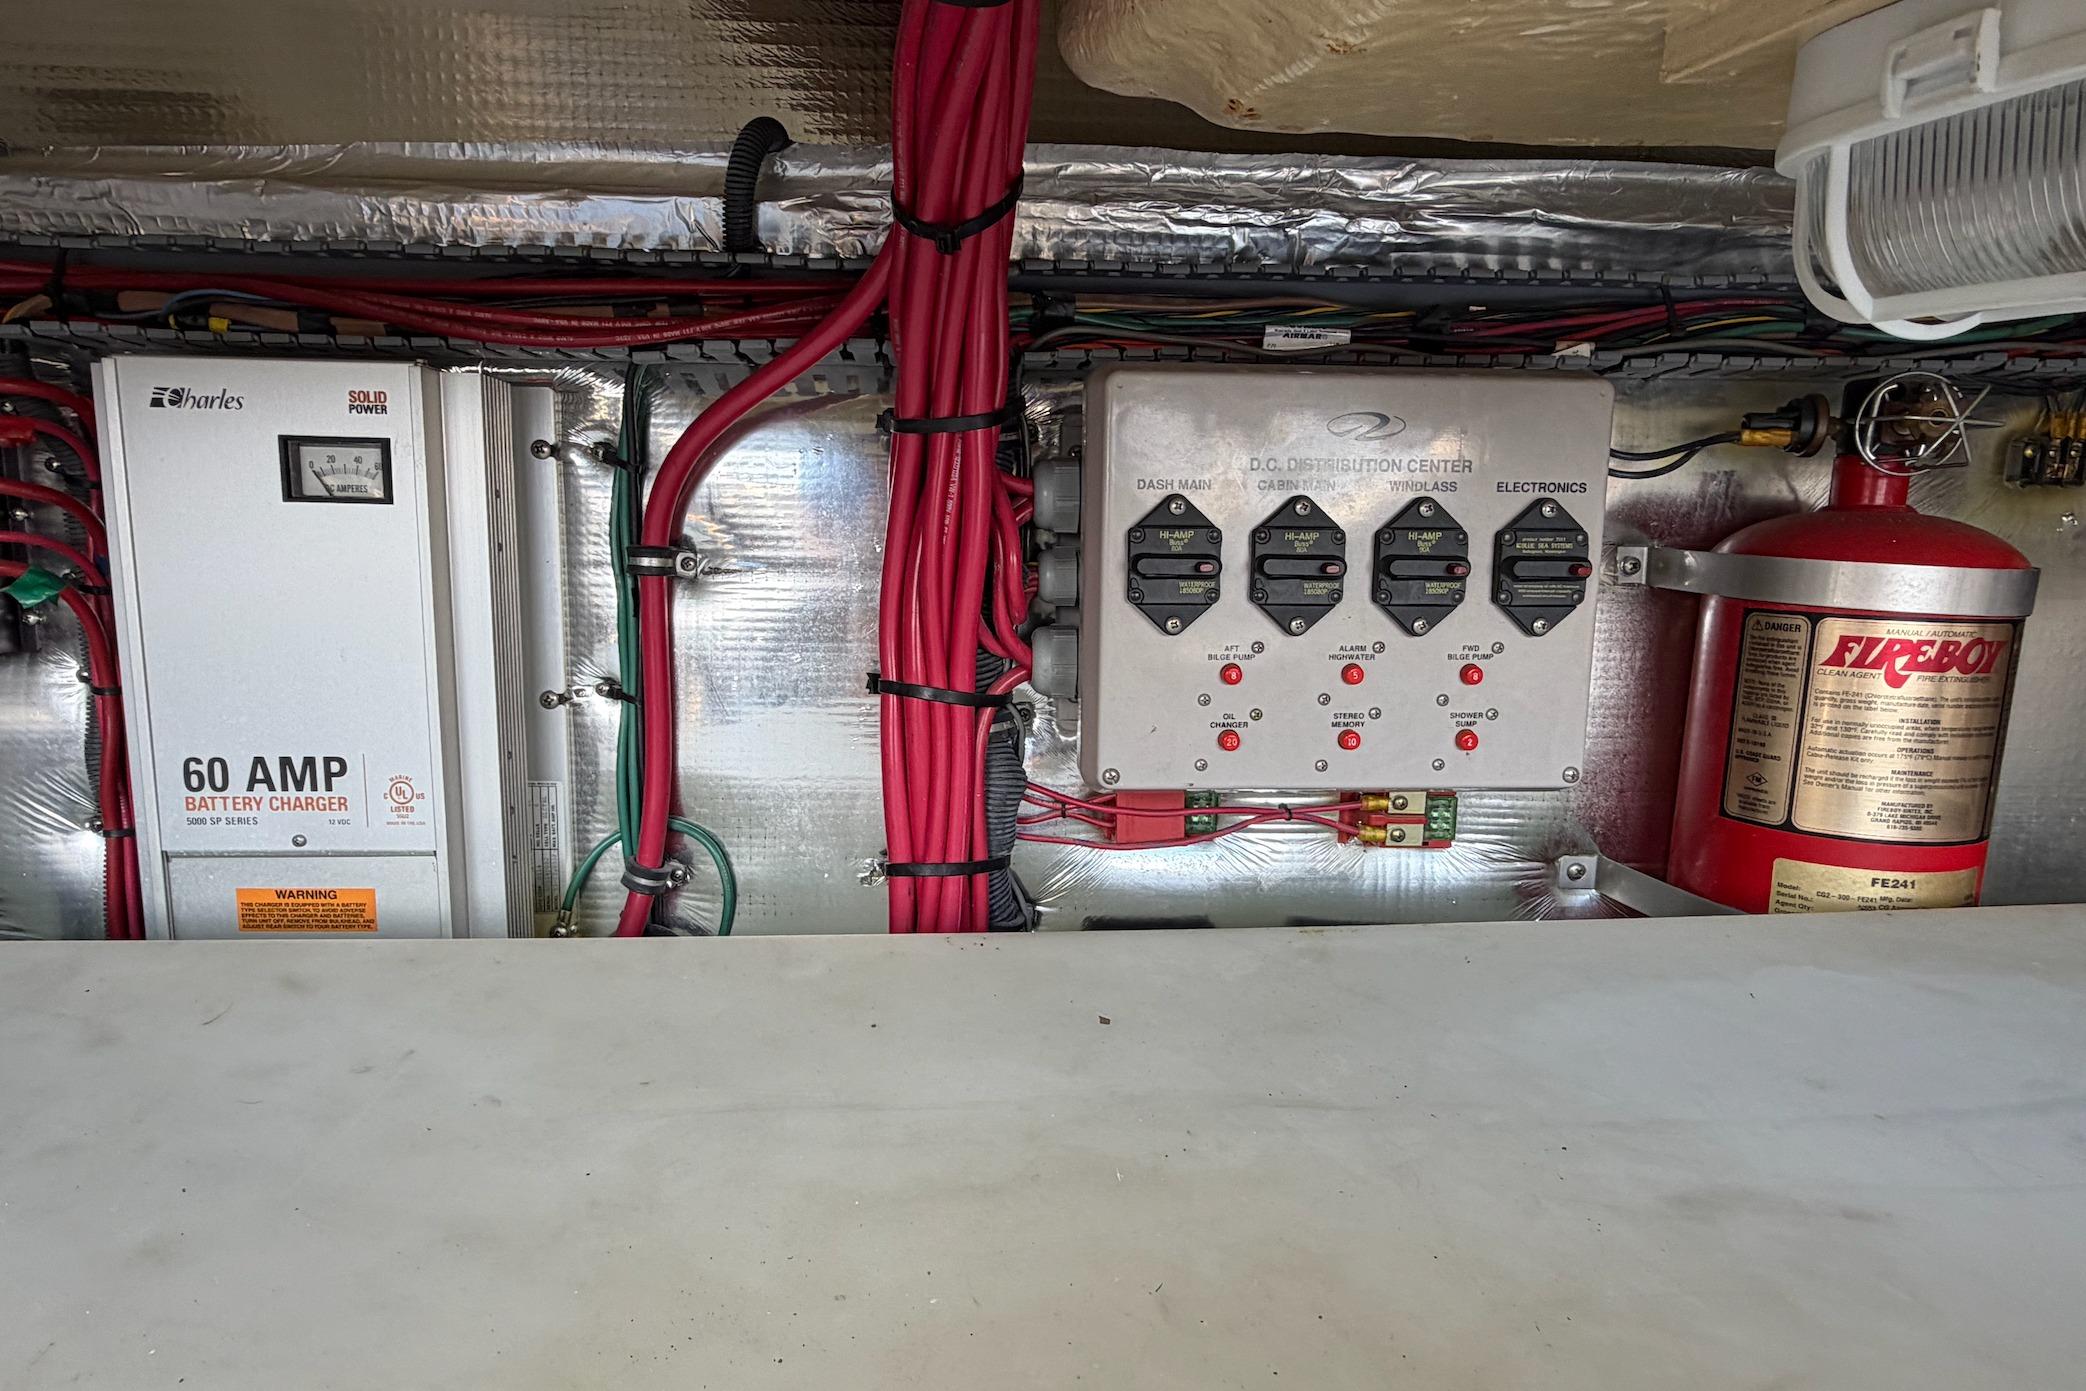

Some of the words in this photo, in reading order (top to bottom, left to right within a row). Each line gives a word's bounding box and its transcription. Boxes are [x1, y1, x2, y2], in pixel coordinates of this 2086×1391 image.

[166, 387, 244, 410] Charles
[349, 391, 387, 403] SOLID
[349, 404, 388, 414] POWER
[326, 455, 336, 464] 20
[354, 456, 363, 464] 40
[309, 461, 314, 469] 0
[1250, 457, 1281, 471] D.C.
[1287, 458, 1402, 473] DISTRIBUTION
[1407, 459, 1473, 473] CENTER
[336, 485, 368, 493] AMPERES
[1137, 479, 1174, 490] DASH
[1179, 479, 1212, 490] MAIN
[1258, 480, 1299, 491] CABIN
[1303, 481, 1336, 492] MAIN
[1389, 481, 1458, 492] WINDLASS
[1496, 482, 1588, 493] ELECTRONICS
[1160, 531, 1194, 539] HI-AMP
[1285, 532, 1319, 541] HI-AMP
[1408, 532, 1442, 541] HI-AMP
[1764, 622, 1801, 632] DANGER
[1886, 628, 1924, 637] MANUAL
[1930, 630, 1978, 638] AUTOMATIC
[1819, 635, 2007, 688] FIREBOY
[1231, 672, 1237, 680] 8
[1353, 671, 1358, 679] 5
[1473, 672, 1479, 681] 8
[1816, 668, 1849, 678] CLEAN
[1850, 671, 1883, 680] AGENT
[1226, 737, 1238, 746] 20
[1348, 738, 1356, 746] 10
[1467, 738, 1473, 746] 2
[183, 757, 229, 792] 60
[246, 756, 348, 792] AMP
[395, 785, 408, 800] UL
[416, 792, 425, 800] US
[185, 796, 263, 811] BATTERY
[269, 796, 348, 811] CHARGER
[390, 805, 415, 813] LISTED
[186, 817, 207, 826] 5000
[210, 817, 222, 826] SP
[225, 817, 258, 826] SERIES
[1777, 882, 1801, 892] Model:
[1871, 877, 1916, 889] FE241
[275, 889, 338, 900] WARNING
[1776, 890, 1797, 900] Serial
[1775, 899, 1796, 909] Agent
